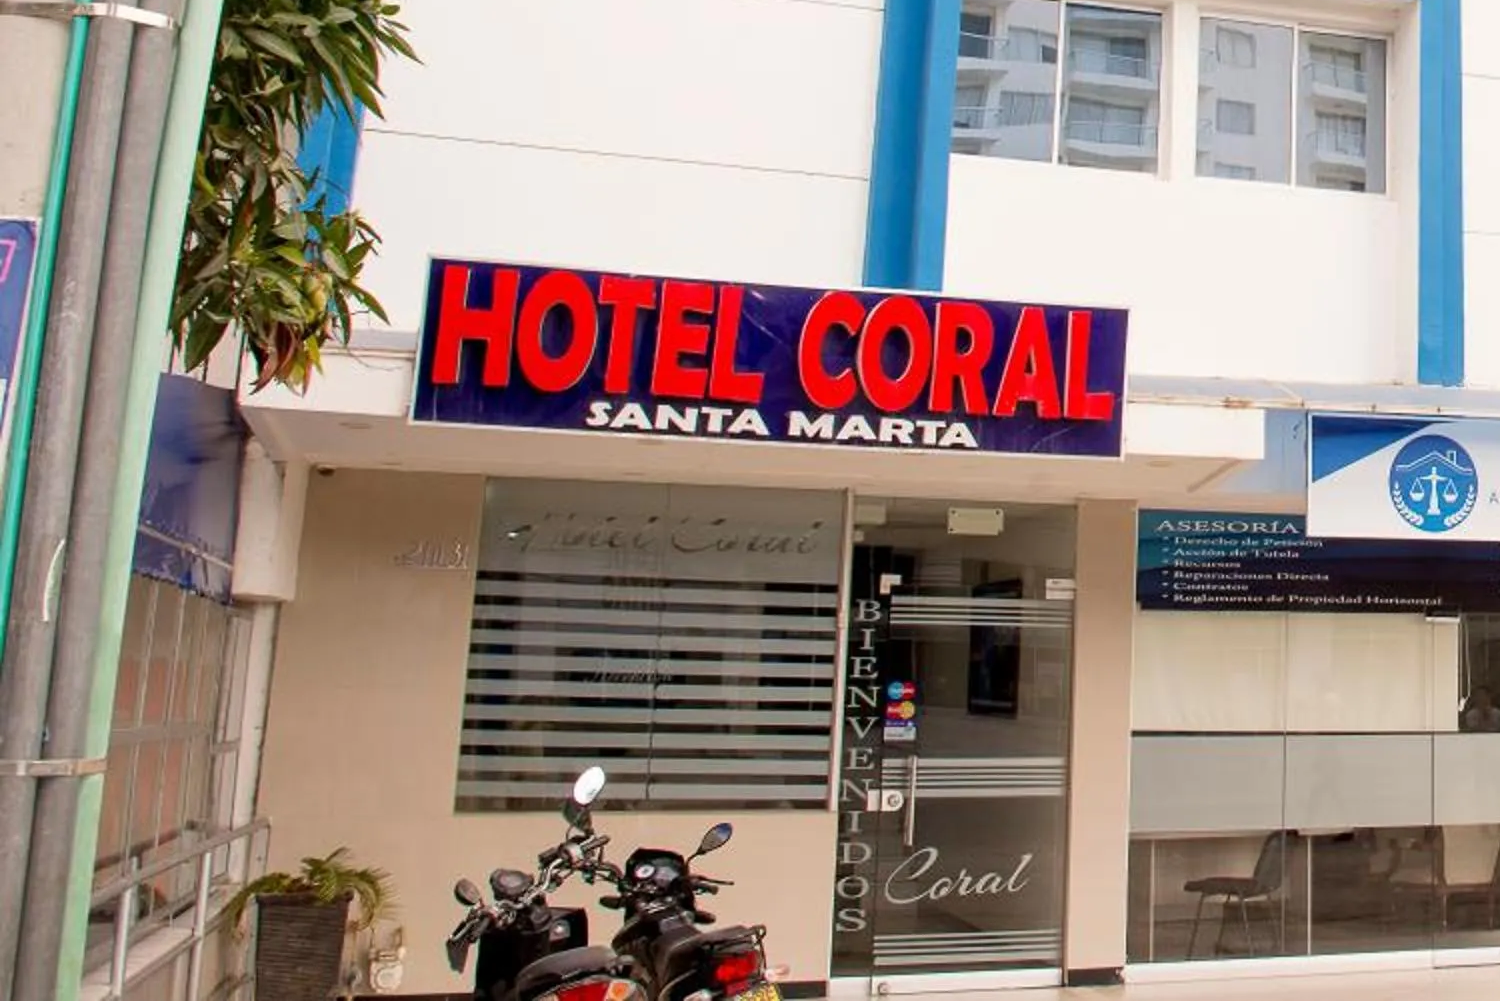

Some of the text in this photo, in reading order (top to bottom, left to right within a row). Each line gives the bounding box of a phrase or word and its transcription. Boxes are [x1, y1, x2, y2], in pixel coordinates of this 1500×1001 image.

[432, 265, 1115, 421] HOTEL CORAL
[585, 401, 979, 448] SANTA MARTA
[1157, 520, 1299, 534] ASESORÍA
[1174, 537, 1238, 547] Derecho
[1241, 538, 1258, 547] de
[1174, 548, 1300, 559] Acción de Tutela
[1174, 559, 1242, 569] Recursos
[1174, 570, 1330, 582] Reparaciones Directa
[1173, 582, 1249, 592] Contratos
[1173, 593, 1262, 605] Reglamento
[1266, 594, 1284, 604] de
[1288, 594, 1361, 606] Propiedad
[836, 599, 882, 933] BIENVENIDOS
[885, 847, 1033, 906] Coral
